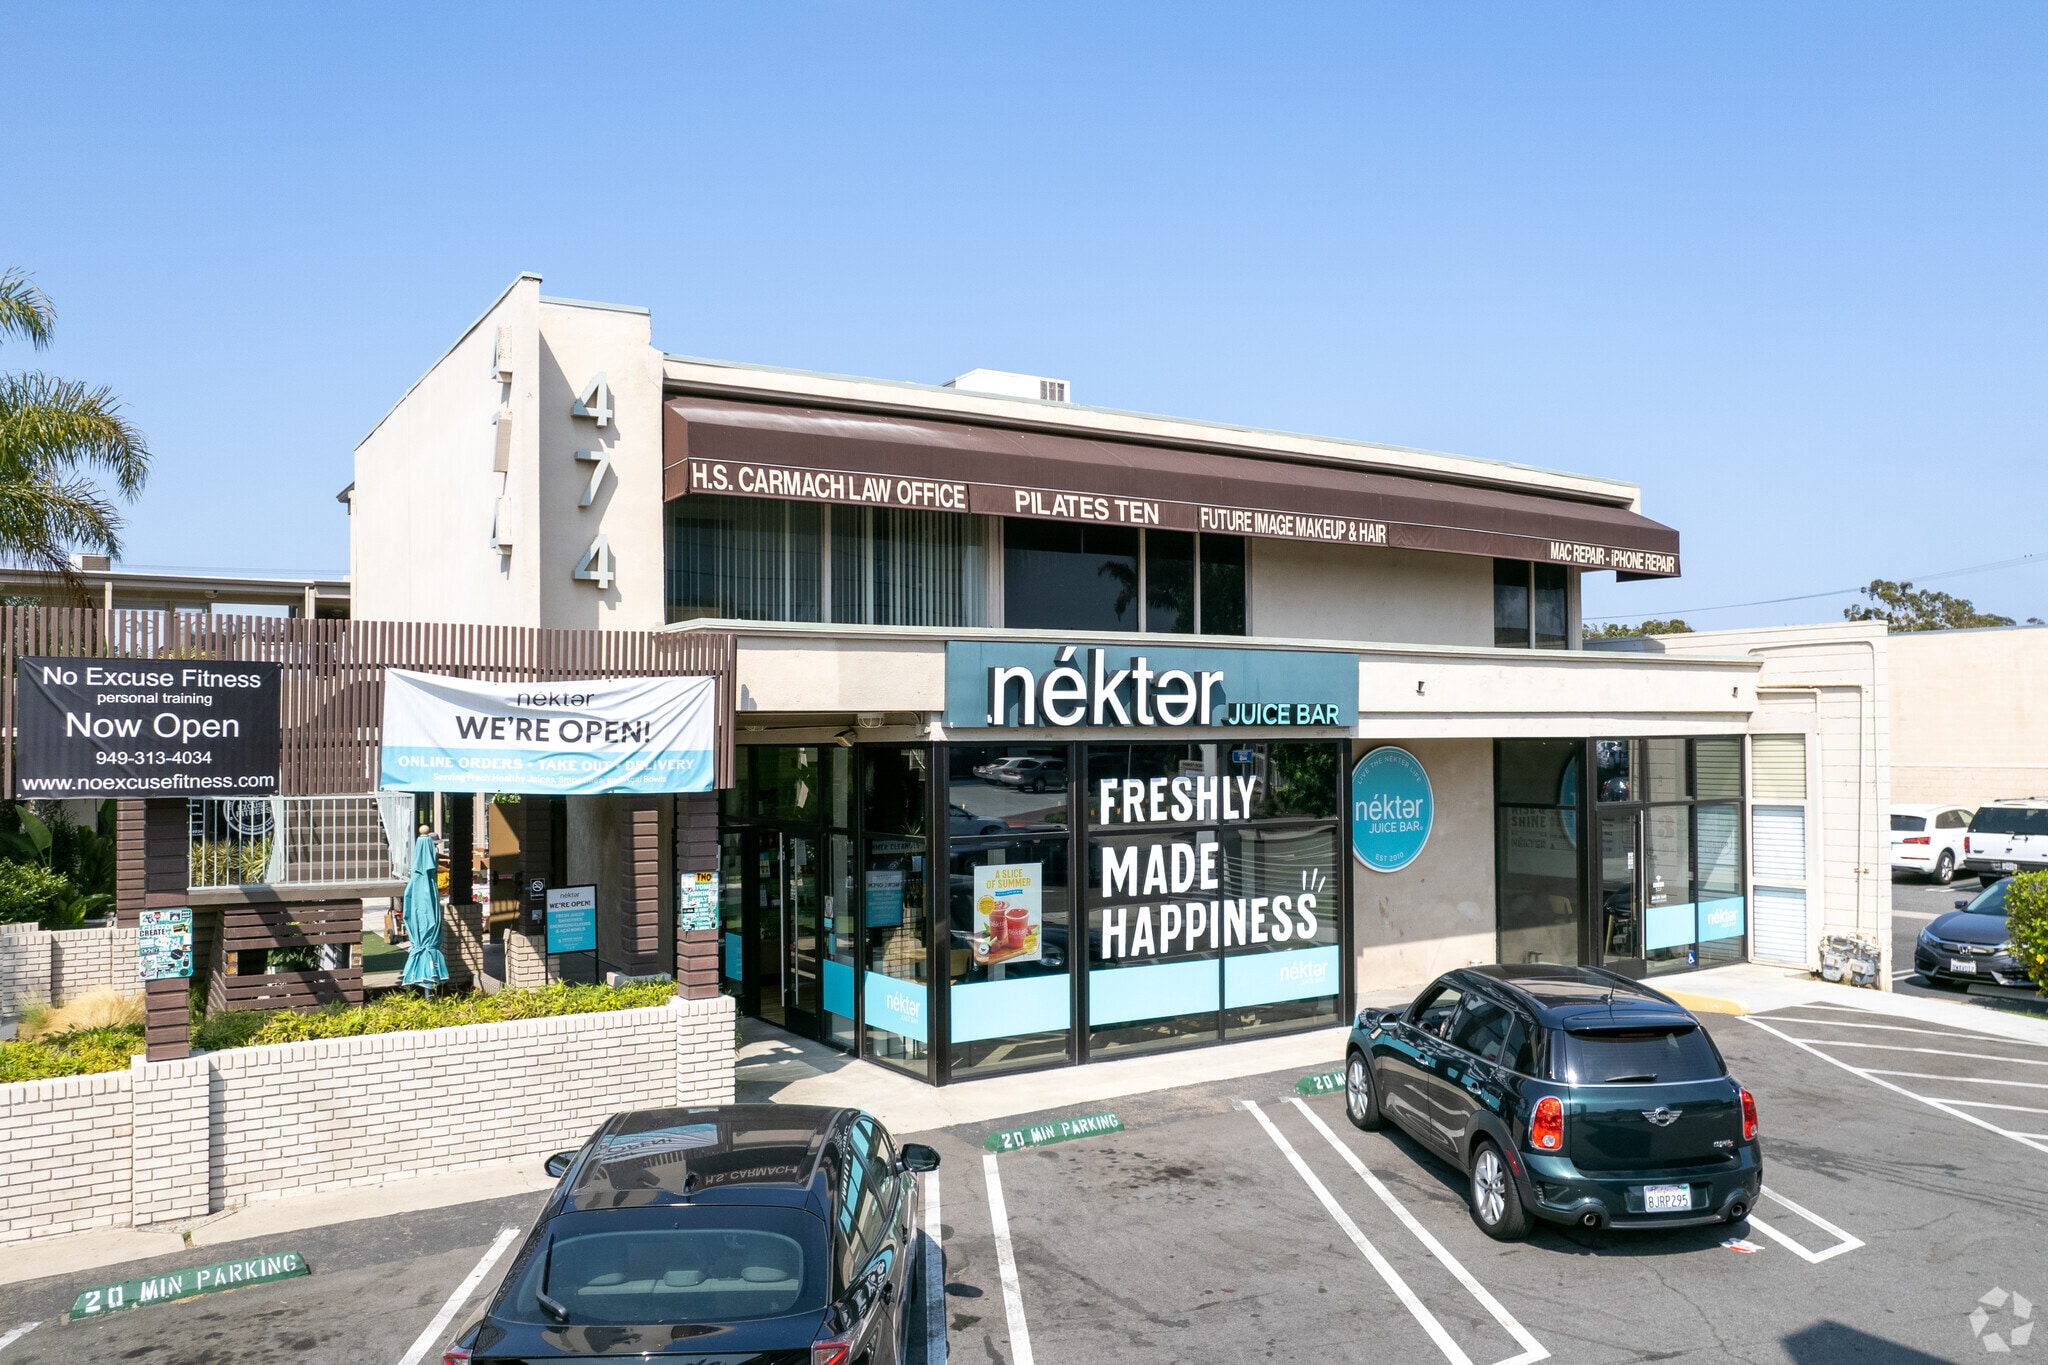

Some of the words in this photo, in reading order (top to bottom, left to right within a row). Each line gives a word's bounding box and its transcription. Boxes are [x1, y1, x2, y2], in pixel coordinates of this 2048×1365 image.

[691, 462, 734, 492] H.S.
[738, 467, 844, 500] CARMACH
[849, 476, 891, 503] LAW
[897, 480, 966, 510] OFFICE
[1014, 490, 1109, 521] PILATES
[1114, 498, 1159, 524] TEN
[1201, 507, 1252, 532] FUTURE
[1254, 512, 1294, 536] IMAGE
[1295, 516, 1347, 540] MAKEUP
[1348, 522, 1357, 542] &
[1359, 523, 1387, 544] HAIR
[1550, 542, 1572, 560] MAC
[1573, 544, 1605, 565] REPAIR
[1611, 549, 1644, 570] iPHONE
[1645, 553, 1675, 573] REPAIR
[43, 666, 77, 685] No
[86, 667, 174, 687] Excuse
[182, 669, 261, 688] Fitness
[97, 692, 159, 705] personal
[162, 692, 213, 706] training
[1228, 703, 1290, 726] JUICE
[1297, 703, 1340, 726] BAR
[66, 712, 141, 738] Now
[153, 713, 240, 743] Open
[455, 716, 550, 741] WE'RE
[558, 720, 651, 744] OPEN!
[96, 751, 212, 765] 949-313-4034
[398, 755, 454, 768] ONLINE
[458, 757, 523, 770] ORDERS
[539, 759, 578, 771] TAKE
[581, 760, 613, 772] OUT
[625, 759, 694, 771] DELIVERY
[433, 773, 466, 783] Serving
[466, 773, 490, 782] Fresh
[493, 774, 525, 784] Healthy
[643, 775, 667, 784] Bowls
[1357, 768, 1370, 785] LIVE
[1370, 757, 1382, 768] THE
[1409, 767, 1421, 783] LIFE
[22, 774, 274, 791] www.noexcusefitness.com
[1100, 775, 1257, 825] FRESHLY
[1369, 822, 1397, 834] JUICE
[1511, 816, 1546, 828] SHINE
[1376, 854, 1387, 862] EST
[1389, 852, 1404, 862] 2010
[995, 870, 1000, 879] A
[1002, 868, 1023, 879] SLICE
[1101, 842, 1219, 898] MADE
[986, 879, 995, 889] OF
[998, 878, 1031, 889] SUMMER
[140, 928, 165, 937] CREATE
[1101, 893, 1319, 959] HAPPINESS
[1313, 1075, 1333, 1090] 20
[1001, 1131, 1025, 1149] 20
[1030, 1125, 1056, 1143] MIN
[1061, 1113, 1119, 1136] PARKING
[1648, 1194, 1689, 1209] 8JRP295
[85, 1285, 123, 1313] 20
[140, 1275, 183, 1302] MIN
[197, 1254, 297, 1290] PARKING
